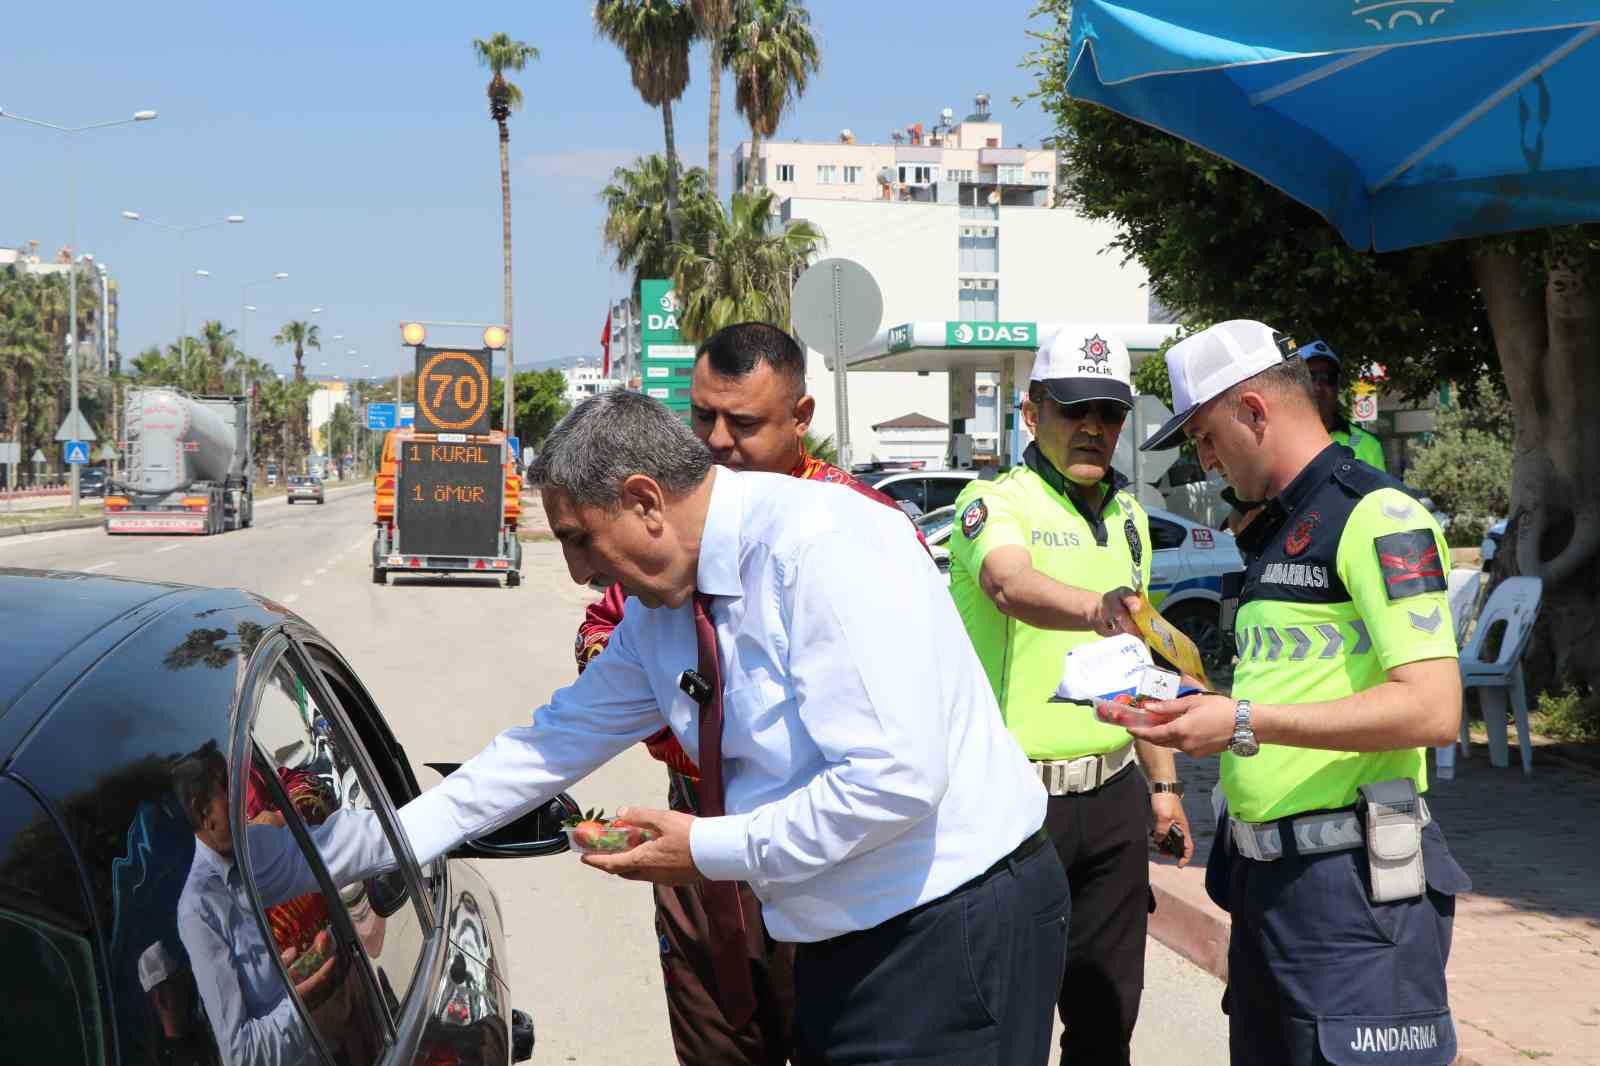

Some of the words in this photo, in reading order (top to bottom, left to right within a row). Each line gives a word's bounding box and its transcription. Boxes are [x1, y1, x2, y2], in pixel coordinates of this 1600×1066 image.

[647, 314, 680, 330] DA
[977, 326, 1030, 342] DAS
[429, 374, 478, 409] 70
[409, 446, 422, 463] 1
[432, 445, 488, 464] KURAL
[412, 483, 425, 503] 1
[433, 484, 485, 503] ÖMÜR
[1350, 1024, 1438, 1052] JANDARMA
